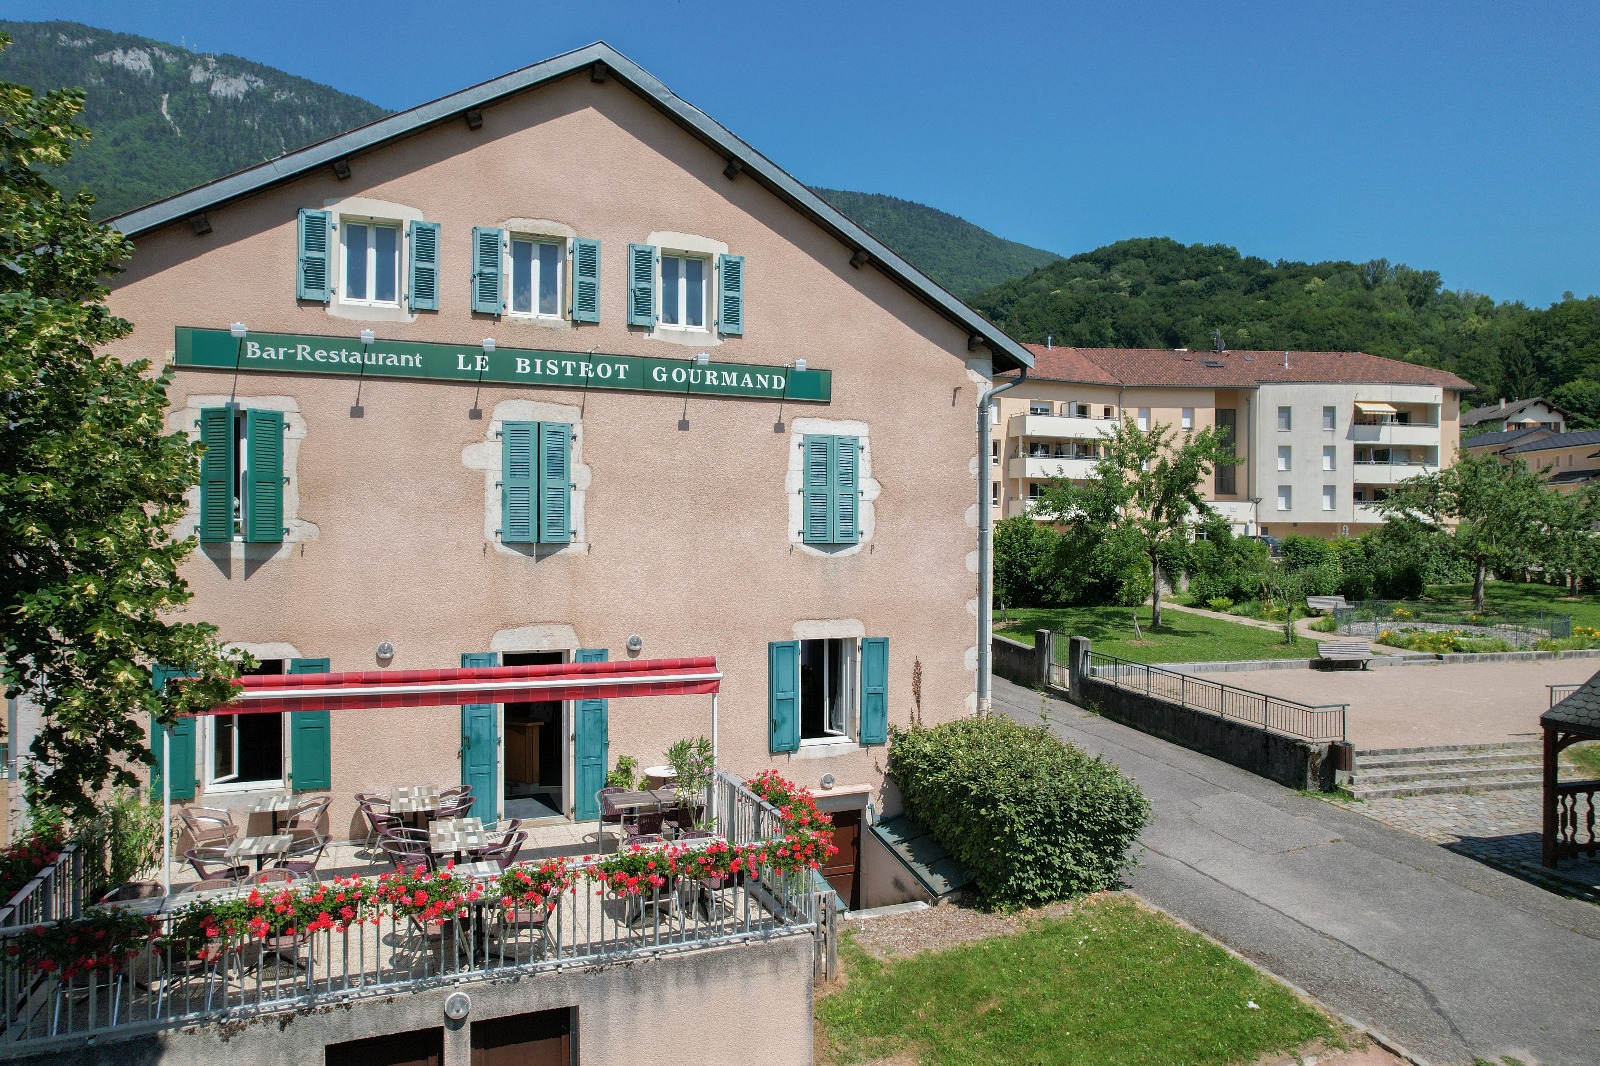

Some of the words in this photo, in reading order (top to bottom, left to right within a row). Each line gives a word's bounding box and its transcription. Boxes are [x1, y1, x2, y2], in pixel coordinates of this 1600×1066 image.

[246, 341, 422, 368] Bar-Restaurant
[456, 354, 489, 372] LE
[515, 357, 629, 380] BISTROT
[652, 366, 786, 390] GOURMAND
